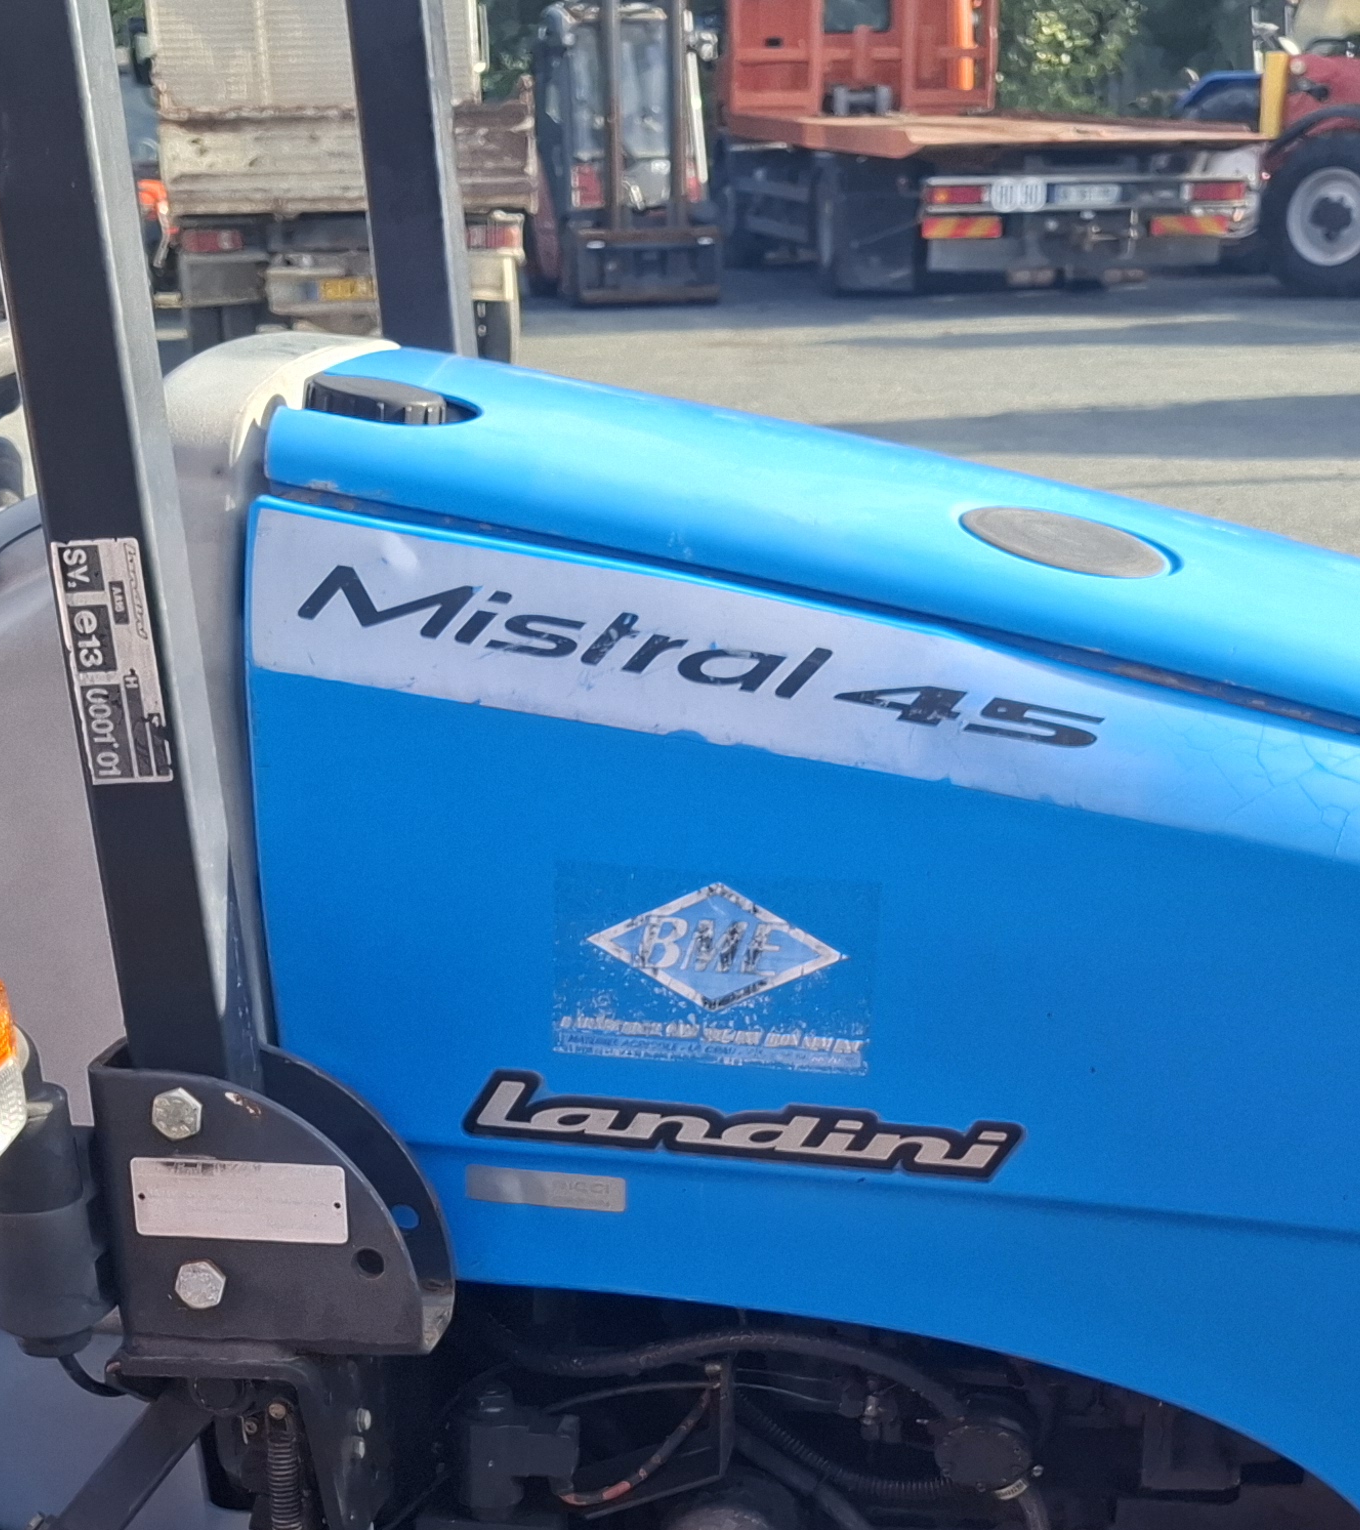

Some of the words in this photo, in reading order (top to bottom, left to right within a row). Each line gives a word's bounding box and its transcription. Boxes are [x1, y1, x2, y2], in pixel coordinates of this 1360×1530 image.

[73, 612, 104, 669] e13
[297, 564, 834, 699] Mistral
[834, 685, 1106, 748] 45
[474, 1078, 1010, 1171] Landini
